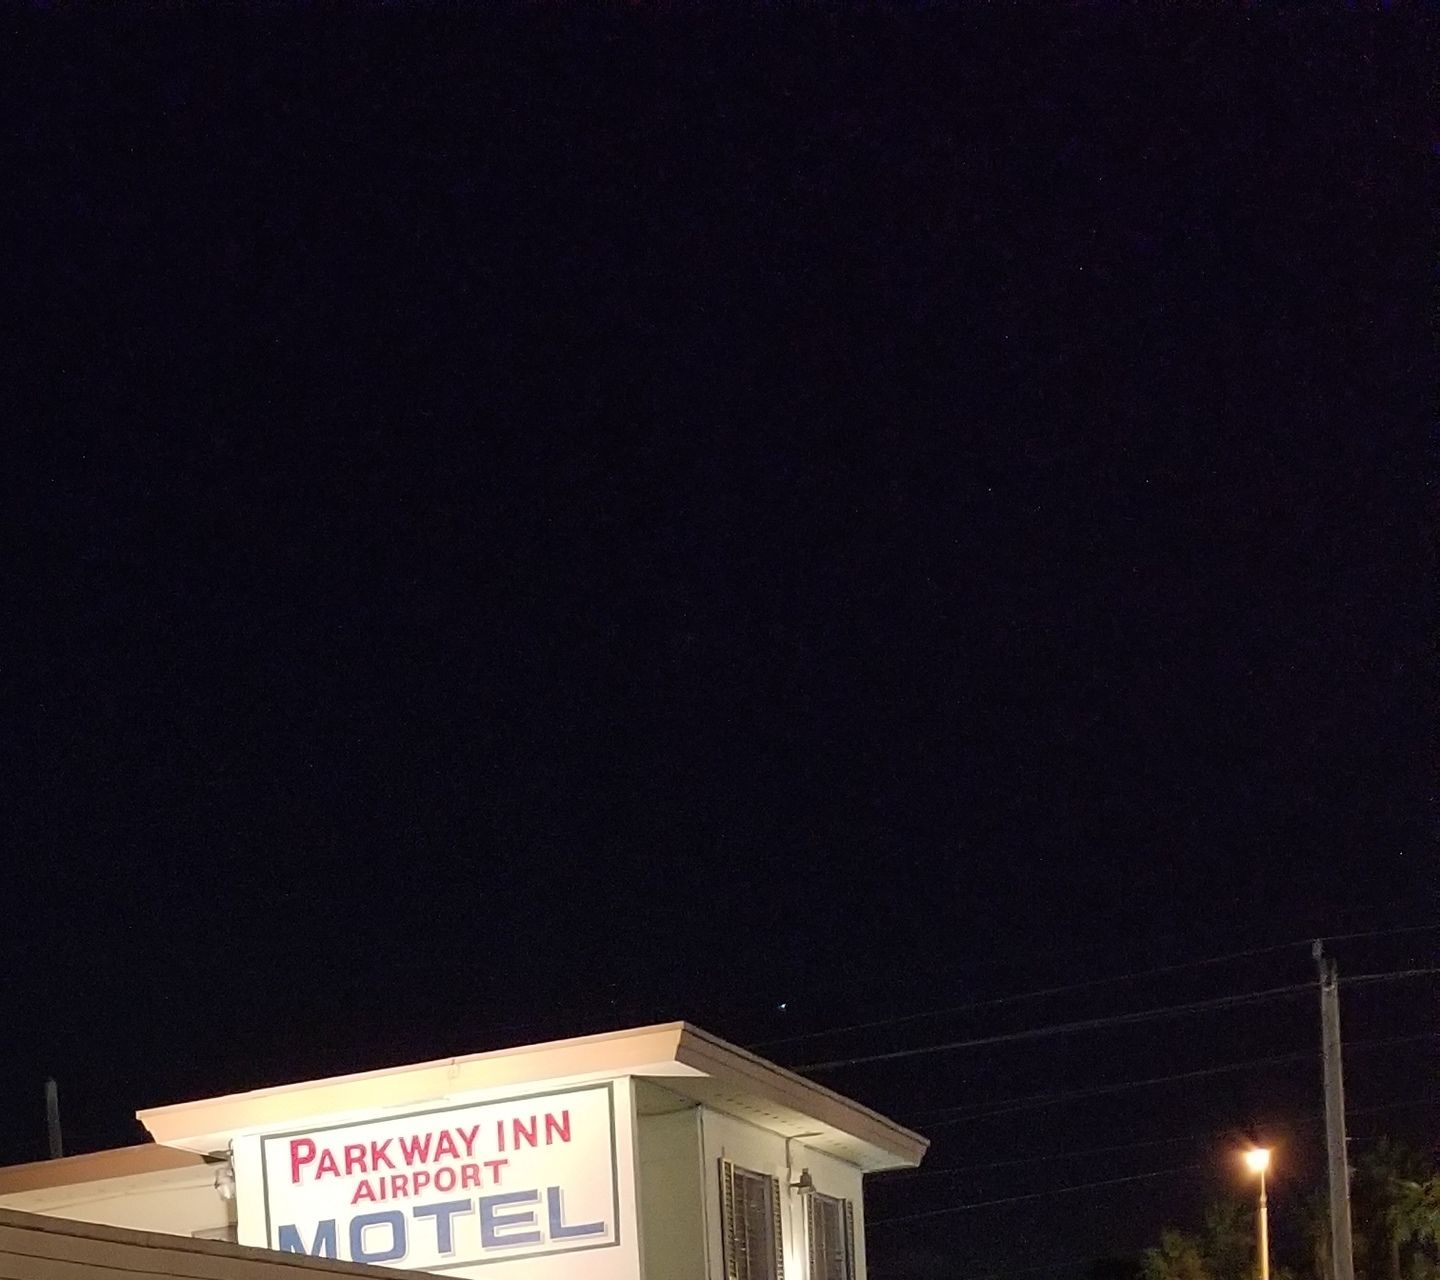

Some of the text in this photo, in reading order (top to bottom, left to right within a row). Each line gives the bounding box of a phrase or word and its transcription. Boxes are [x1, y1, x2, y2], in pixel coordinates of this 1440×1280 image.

[290, 1110, 572, 1184] PARKWAY INN
[350, 1159, 508, 1205] AIRPORT
[278, 1185, 605, 1264] MOTEL
